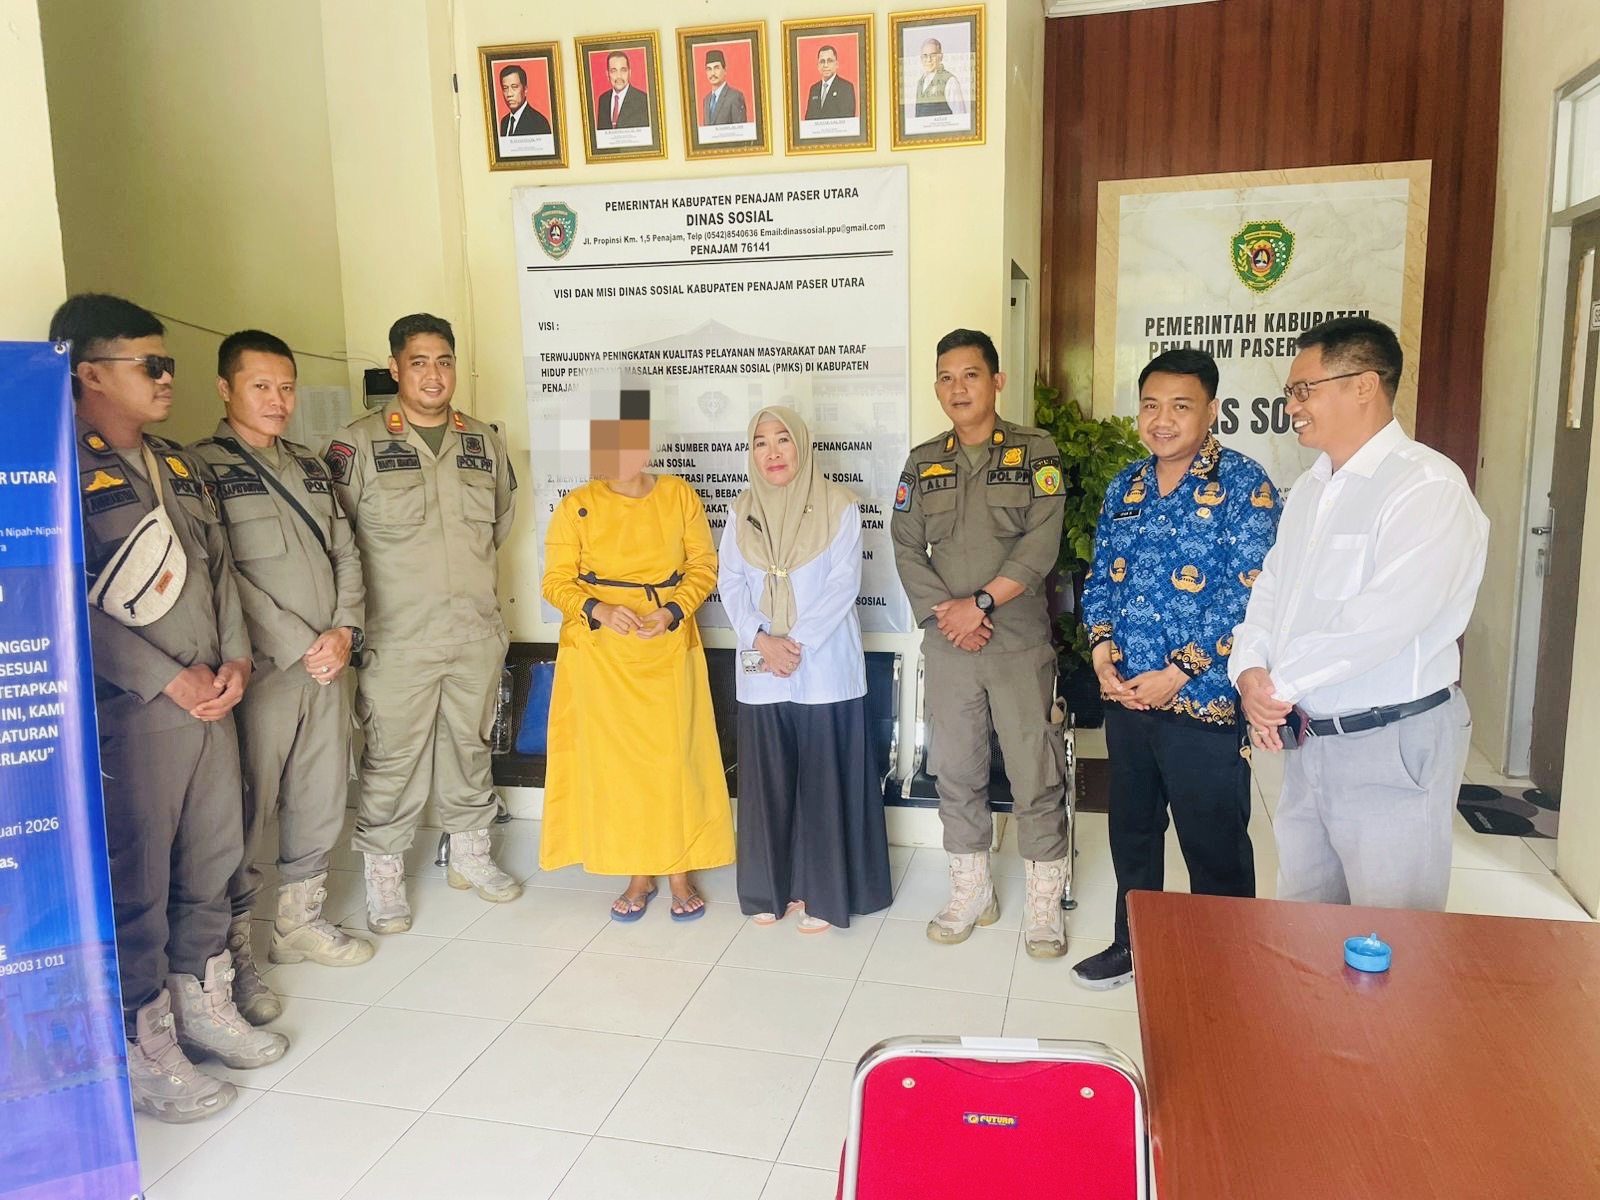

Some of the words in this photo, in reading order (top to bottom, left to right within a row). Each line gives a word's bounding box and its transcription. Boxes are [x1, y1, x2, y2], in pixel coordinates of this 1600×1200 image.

[605, 199, 669, 212] PEMERINTAH
[672, 195, 732, 208] KABUPATEN
[735, 192, 784, 205] PENAJAM
[787, 190, 820, 202] PASER
[823, 187, 859, 200] UTARA
[686, 212, 724, 226] DINAS
[728, 210, 774, 224] SOSIAL
[594, 236, 622, 246] Propinsi
[624, 236, 638, 244] Km.
[640, 235, 651, 243] 1,5
[652, 233, 686, 243] Penajam,
[687, 232, 702, 242] Telp
[690, 243, 738, 255] PENAJAM
[741, 242, 770, 253] 76141
[553, 289, 573, 299] VISI
[575, 288, 594, 298] DAN
[597, 287, 616, 297] MISI
[619, 286, 648, 297] DINAS
[650, 285, 684, 295] SOSIAL
[687, 282, 744, 294] KABUPATEN
[747, 280, 794, 292] PENAJAM
[796, 278, 828, 290] PASER
[831, 277, 865, 289] UTARA
[538, 321, 555, 331] VISI
[1145, 313, 1256, 337] PEMERINTAH
[540, 352, 601, 362] TERWUJUDNYA
[602, 350, 661, 361] PENINGKATAN
[663, 349, 703, 360] KUALITAS
[706, 347, 755, 358] PELAYANAN
[757, 345, 815, 357] MASYARAKAT
[818, 345, 836, 355] DAN
[839, 344, 867, 354] TARAF
[1241, 337, 1297, 358] PASER
[541, 367, 566, 377] HIDUP
[666, 364, 738, 375] KESEJAHTERAAN
[740, 363, 771, 373] SOSIAL
[773, 362, 803, 375] (PMKS)
[805, 362, 814, 372] DI
[817, 360, 869, 371] KABUPATEN
[675, 443, 709, 452] SUMBER
[711, 442, 732, 452] DAYA
[812, 441, 872, 451] PENANGANAN
[666, 458, 696, 468] SOSIAL
[10, 470, 57, 485] UTARA
[832, 472, 863, 482] SOSIAL
[927, 478, 947, 490] ALI
[990, 471, 1011, 482] POL
[5, 526, 62, 539] Nipah-Nipah
[856, 597, 887, 606] SOSIAL
[0, 637, 51, 654] NGGUP
[0, 660, 48, 677] SESUAI
[0, 680, 69, 699] TETAPKAN
[2, 707, 26, 722] INI,
[29, 702, 65, 718] KAMI
[0, 725, 59, 744] ATURAN
[25, 817, 59, 834] 2026
[44, 954, 65, 968] 011
